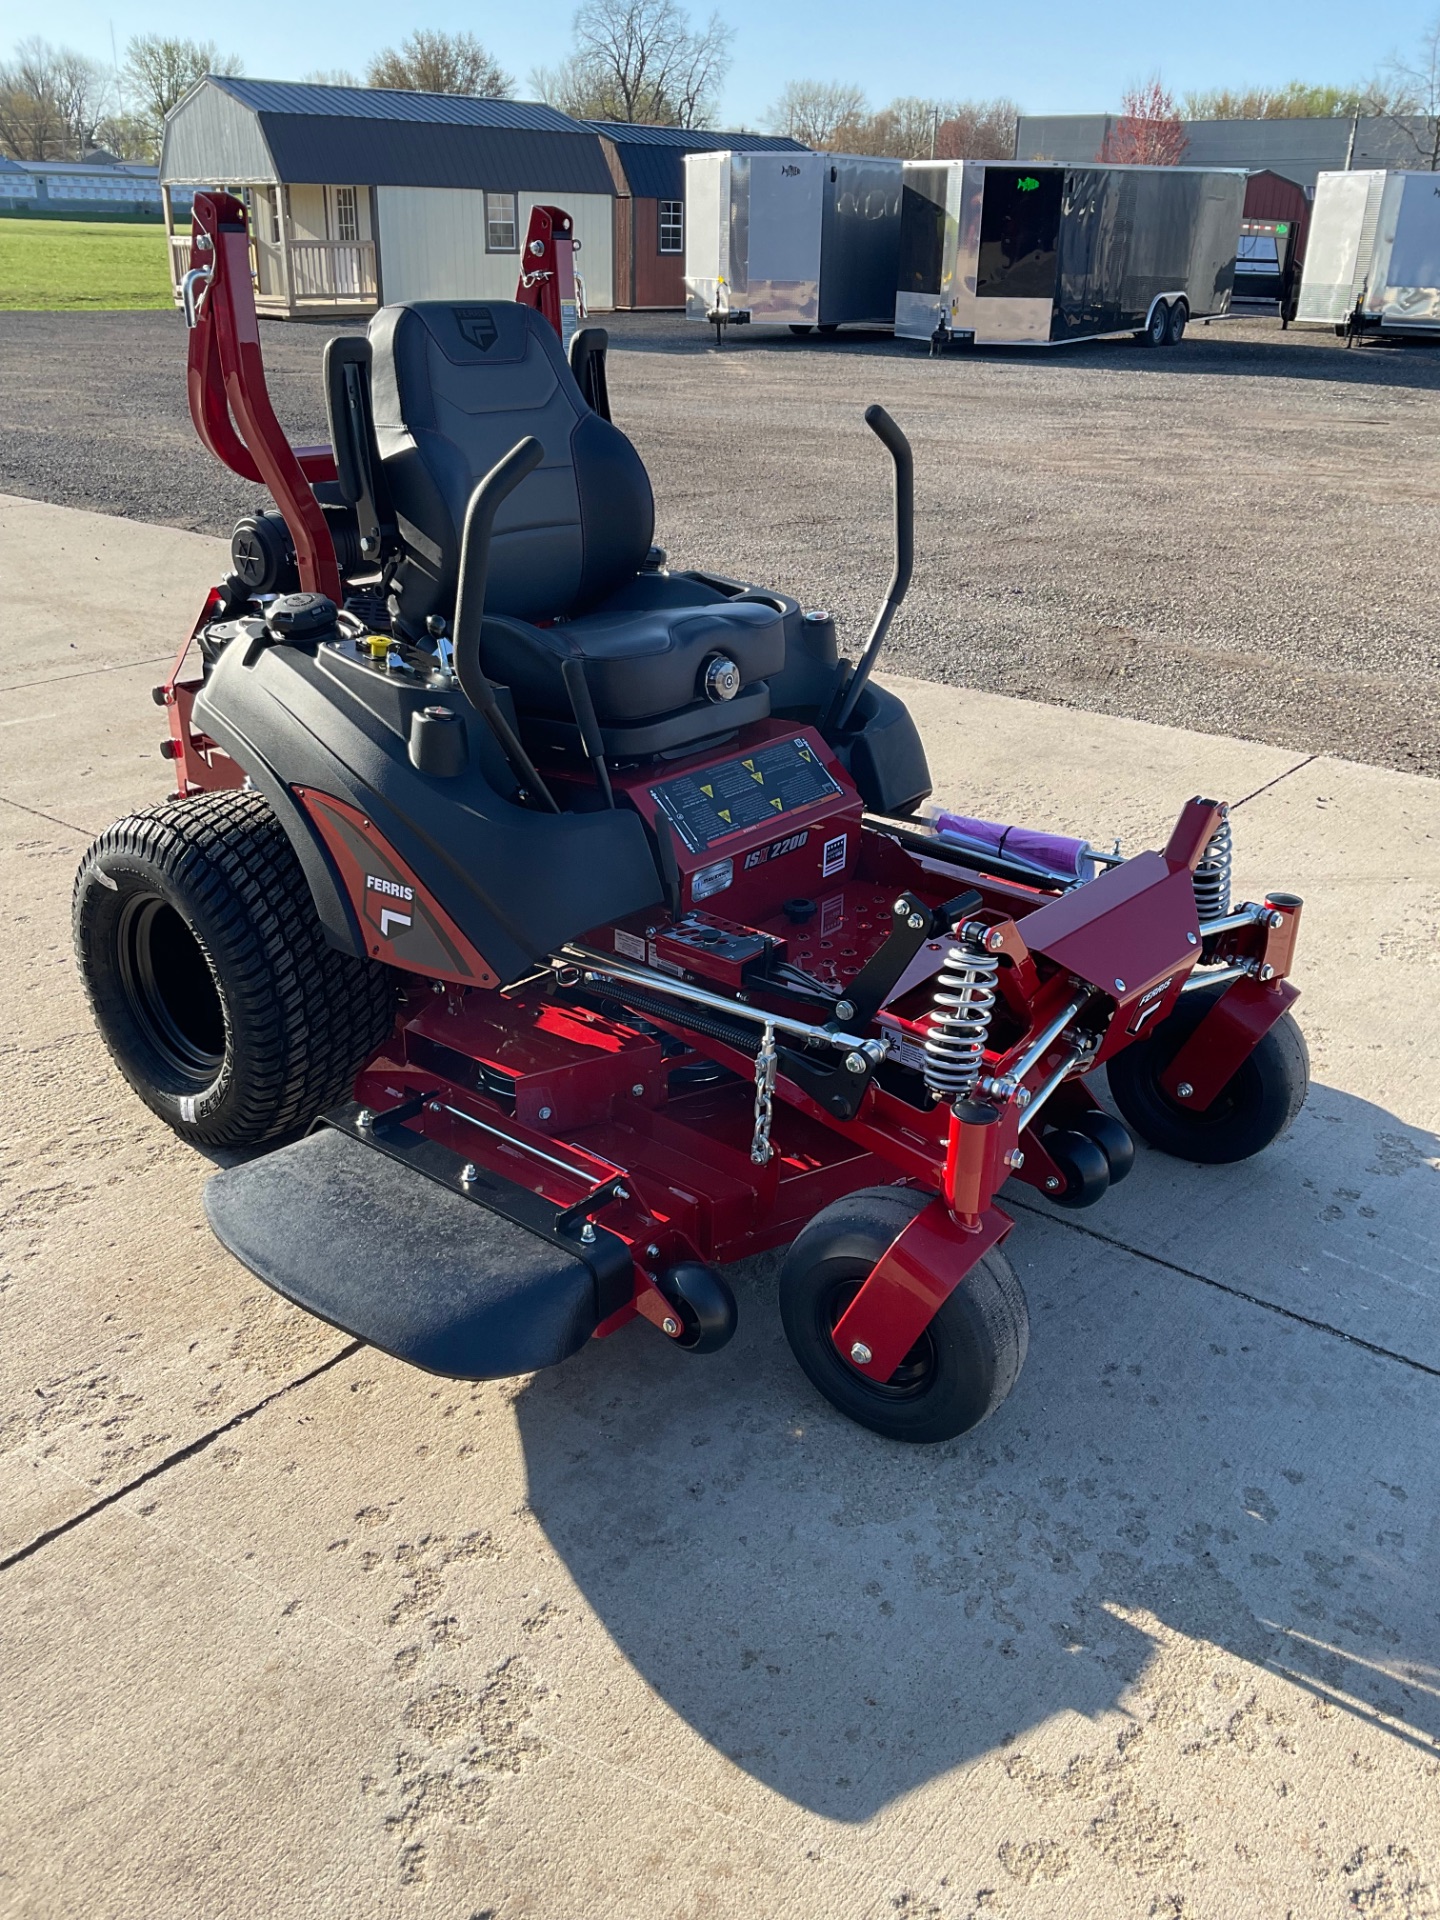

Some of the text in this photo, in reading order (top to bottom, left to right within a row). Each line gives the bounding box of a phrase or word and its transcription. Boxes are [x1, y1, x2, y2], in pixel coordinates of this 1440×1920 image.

[744, 831, 808, 869] ISX 2200
[367, 875, 413, 901] FERRIS
[1139, 978, 1172, 1007] FERRIS
